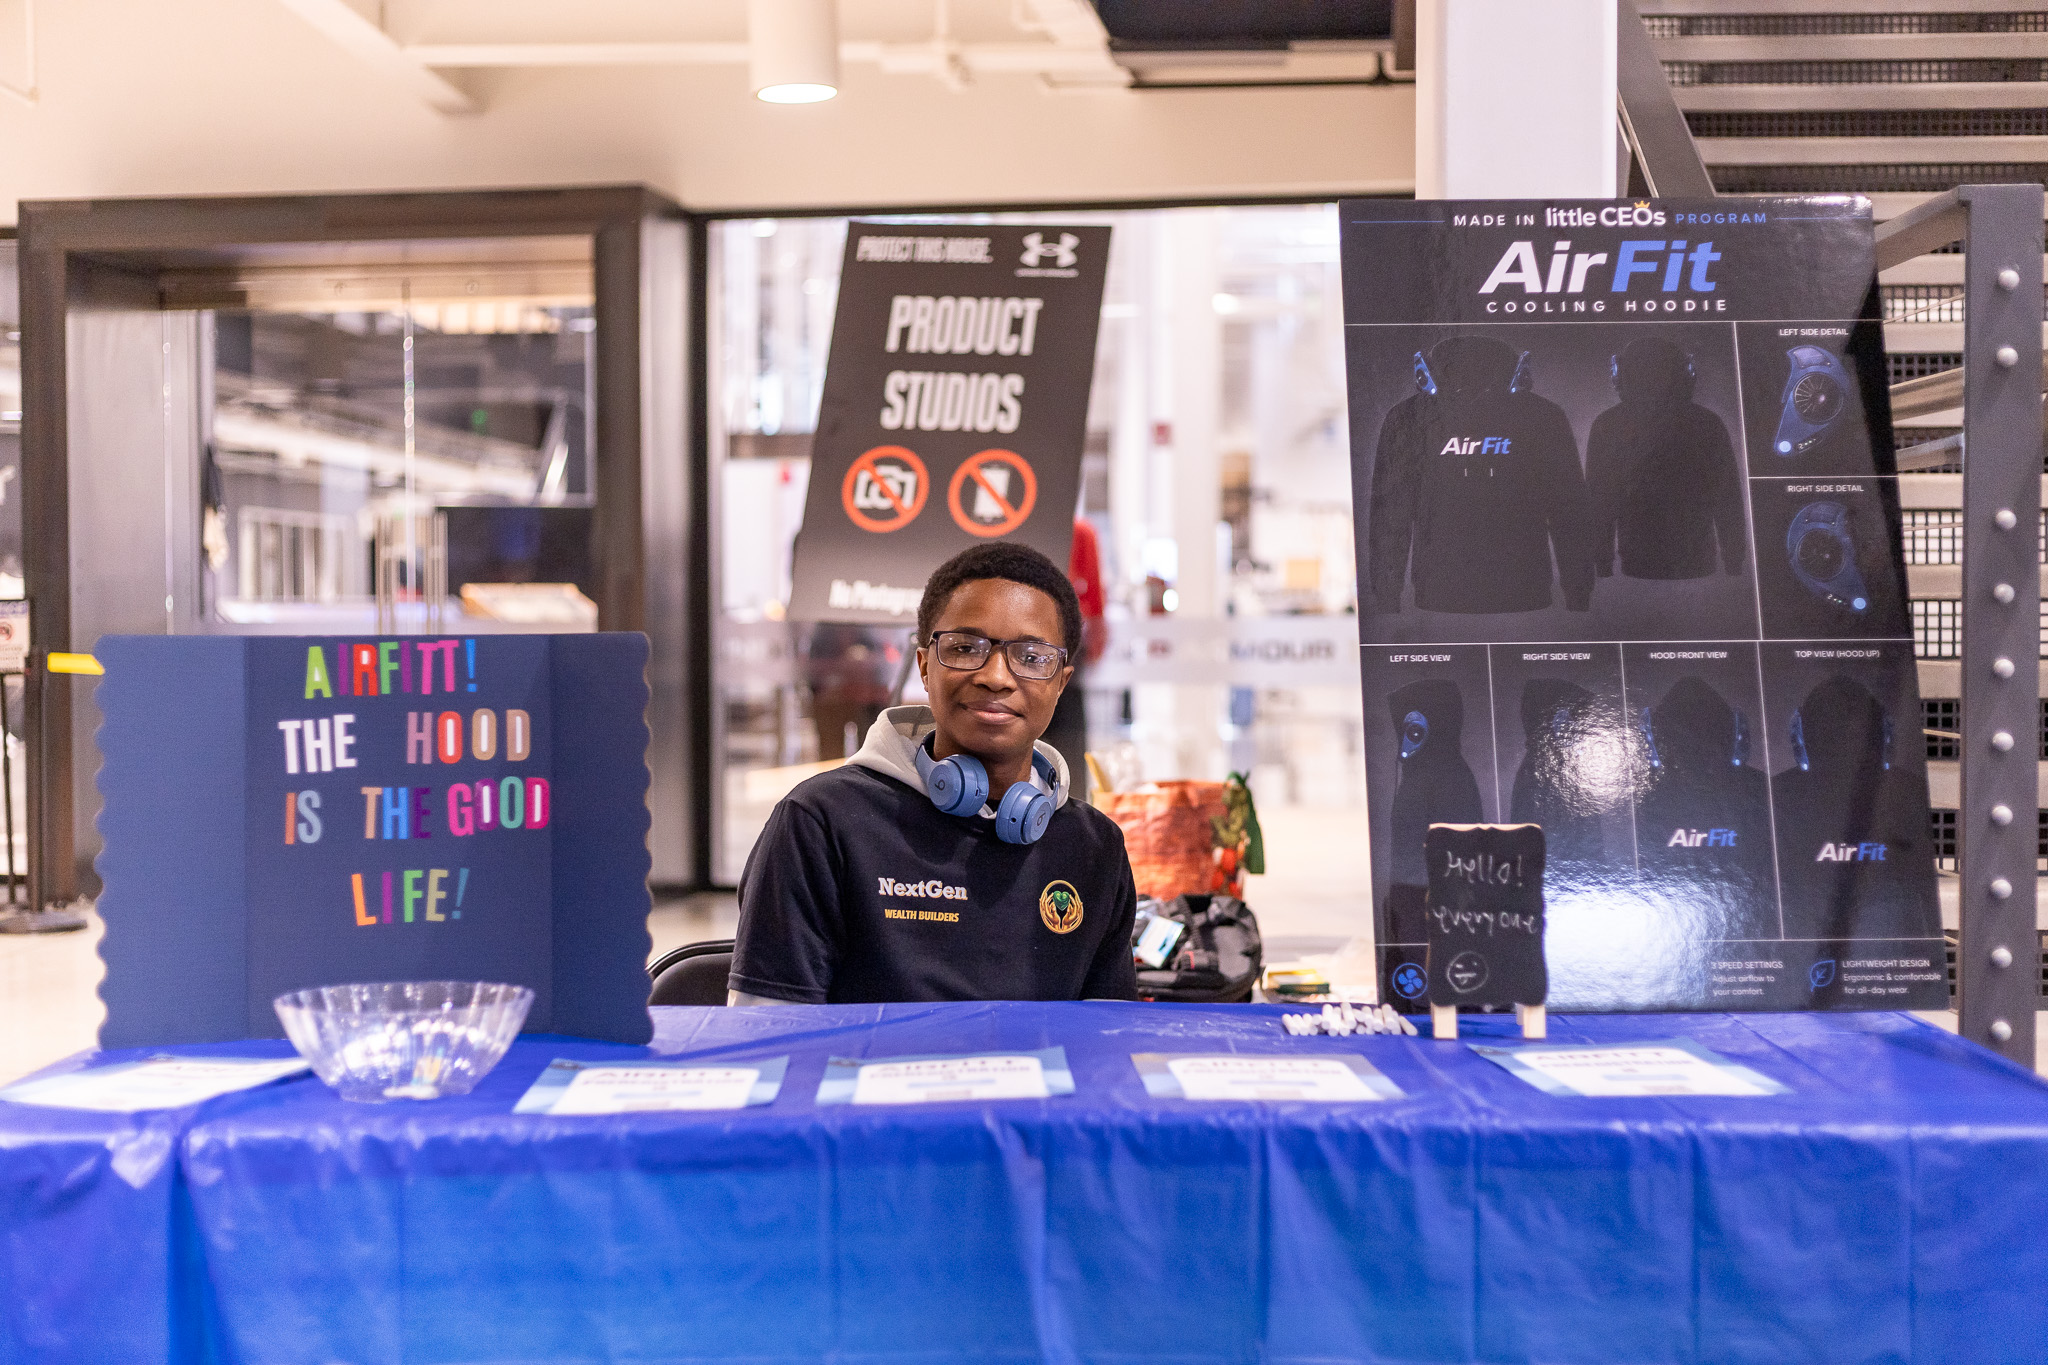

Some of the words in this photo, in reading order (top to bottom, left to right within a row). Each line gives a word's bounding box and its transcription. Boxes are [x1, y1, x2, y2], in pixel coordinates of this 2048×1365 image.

[1454, 215, 1506, 226] MADE
[1516, 214, 1535, 226] IN
[1675, 213, 1767, 224] PROGRAM
[856, 235, 914, 262] PROTECT
[914, 236, 945, 262] THIS
[1486, 300, 1606, 313] COOLING
[1625, 300, 1728, 313] HOODIE
[885, 295, 1044, 356] PRODUCT
[1779, 328, 1798, 336] LEFT
[1800, 328, 1819, 336] SIDE
[880, 370, 1025, 433] STUDIOS
[1836, 484, 1864, 492] DETAIL
[1389, 654, 1408, 662] LEFT
[1410, 654, 1428, 662] SIDE
[1430, 654, 1451, 662] VIEW
[1570, 652, 1590, 660] VIEW
[1677, 651, 1706, 659] FRONT
[1707, 651, 1727, 659] VIEW
[1795, 650, 1813, 658] TOP
[1814, 650, 1834, 658] VIEW
[1836, 650, 1864, 658] (HOOD
[1866, 650, 1880, 658] UP)
[304, 639, 478, 699] AIRFITT!
[278, 713, 358, 774] THE
[406, 708, 530, 764] HOOD
[284, 789, 322, 845] IS
[360, 787, 432, 840] THE
[447, 776, 550, 837] GOOD
[1443, 850, 1524, 888] Hello!
[877, 877, 968, 901] NextGen
[351, 867, 470, 926] LIFE!
[884, 908, 917, 920] WEALTH
[918, 910, 960, 922] BUILDERS
[1719, 961, 1743, 969] SPEED
[1745, 961, 1784, 969] SETTINGS
[1842, 960, 1898, 968] LIGHTWEIGHT
[1713, 975, 1737, 984] Adjust
[1739, 974, 1765, 982] airflow
[1843, 973, 1884, 983] Ergonomic
[1886, 973, 1892, 981] &
[1894, 973, 1942, 981] comfortable
[1844, 986, 1855, 994] for
[1857, 986, 1886, 995] all-day
